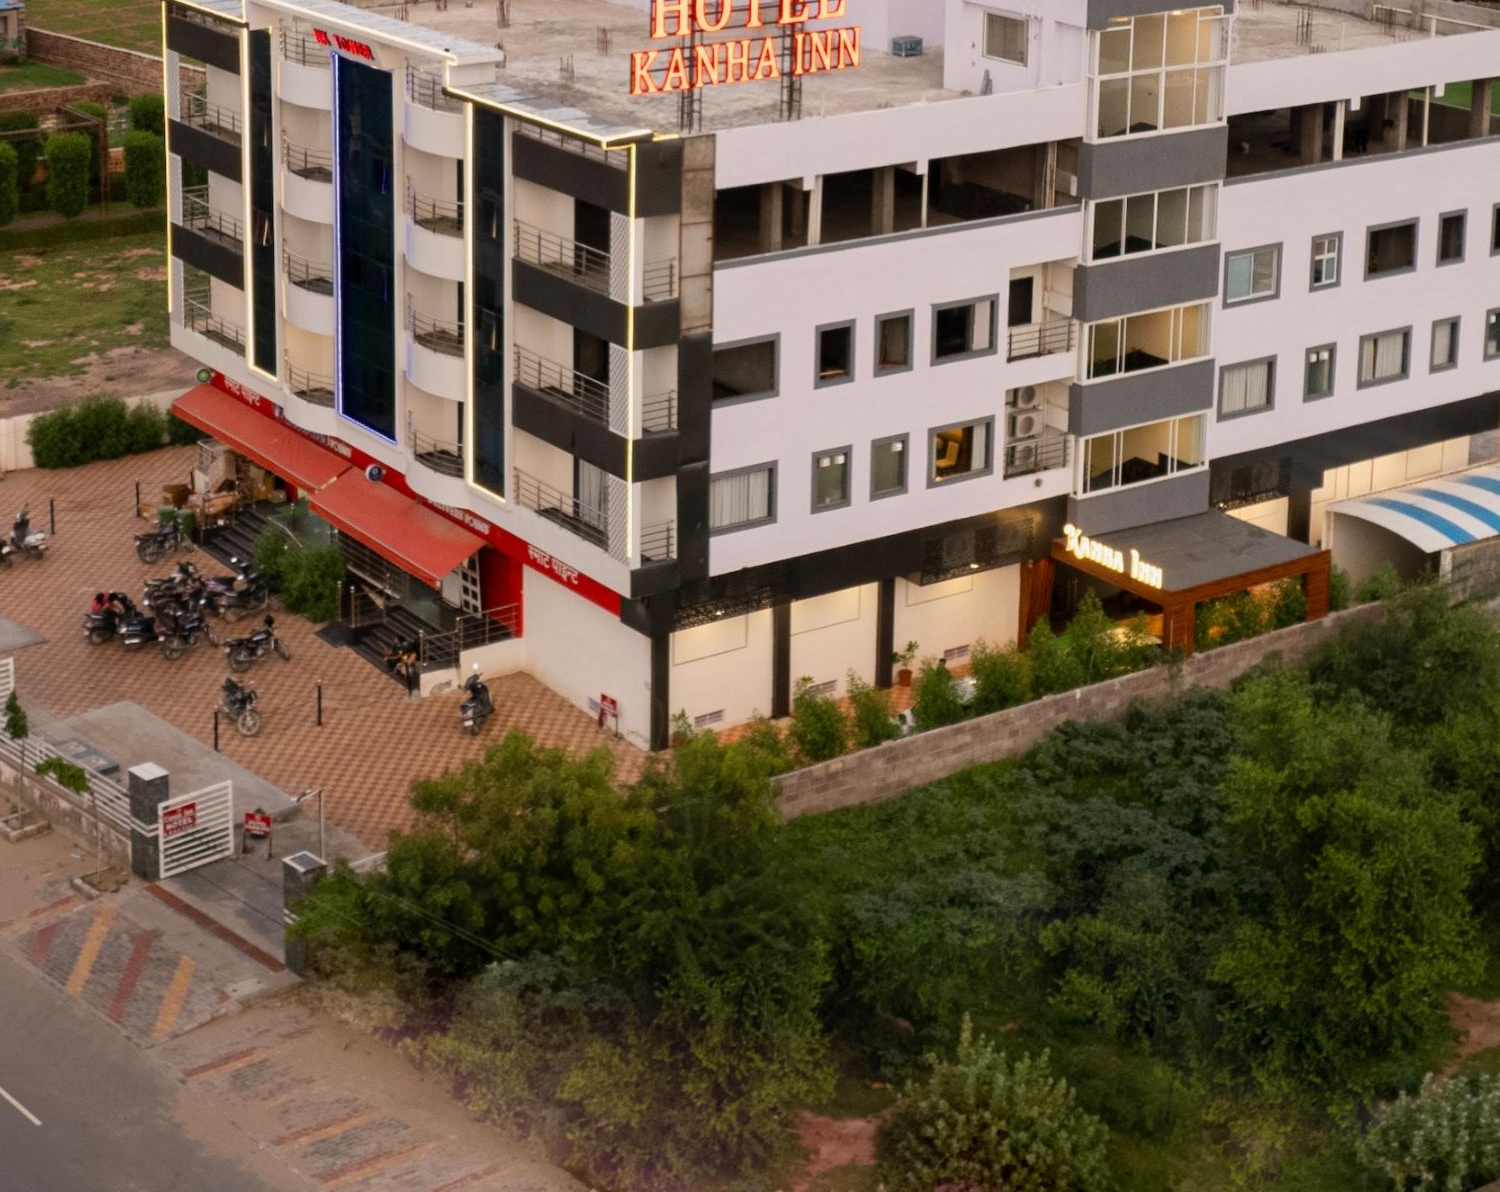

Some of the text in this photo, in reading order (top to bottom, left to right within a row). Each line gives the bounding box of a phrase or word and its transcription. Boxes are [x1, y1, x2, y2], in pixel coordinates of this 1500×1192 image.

[332, 34, 375, 60] TOWER
[630, 25, 861, 95] KANHA INN
